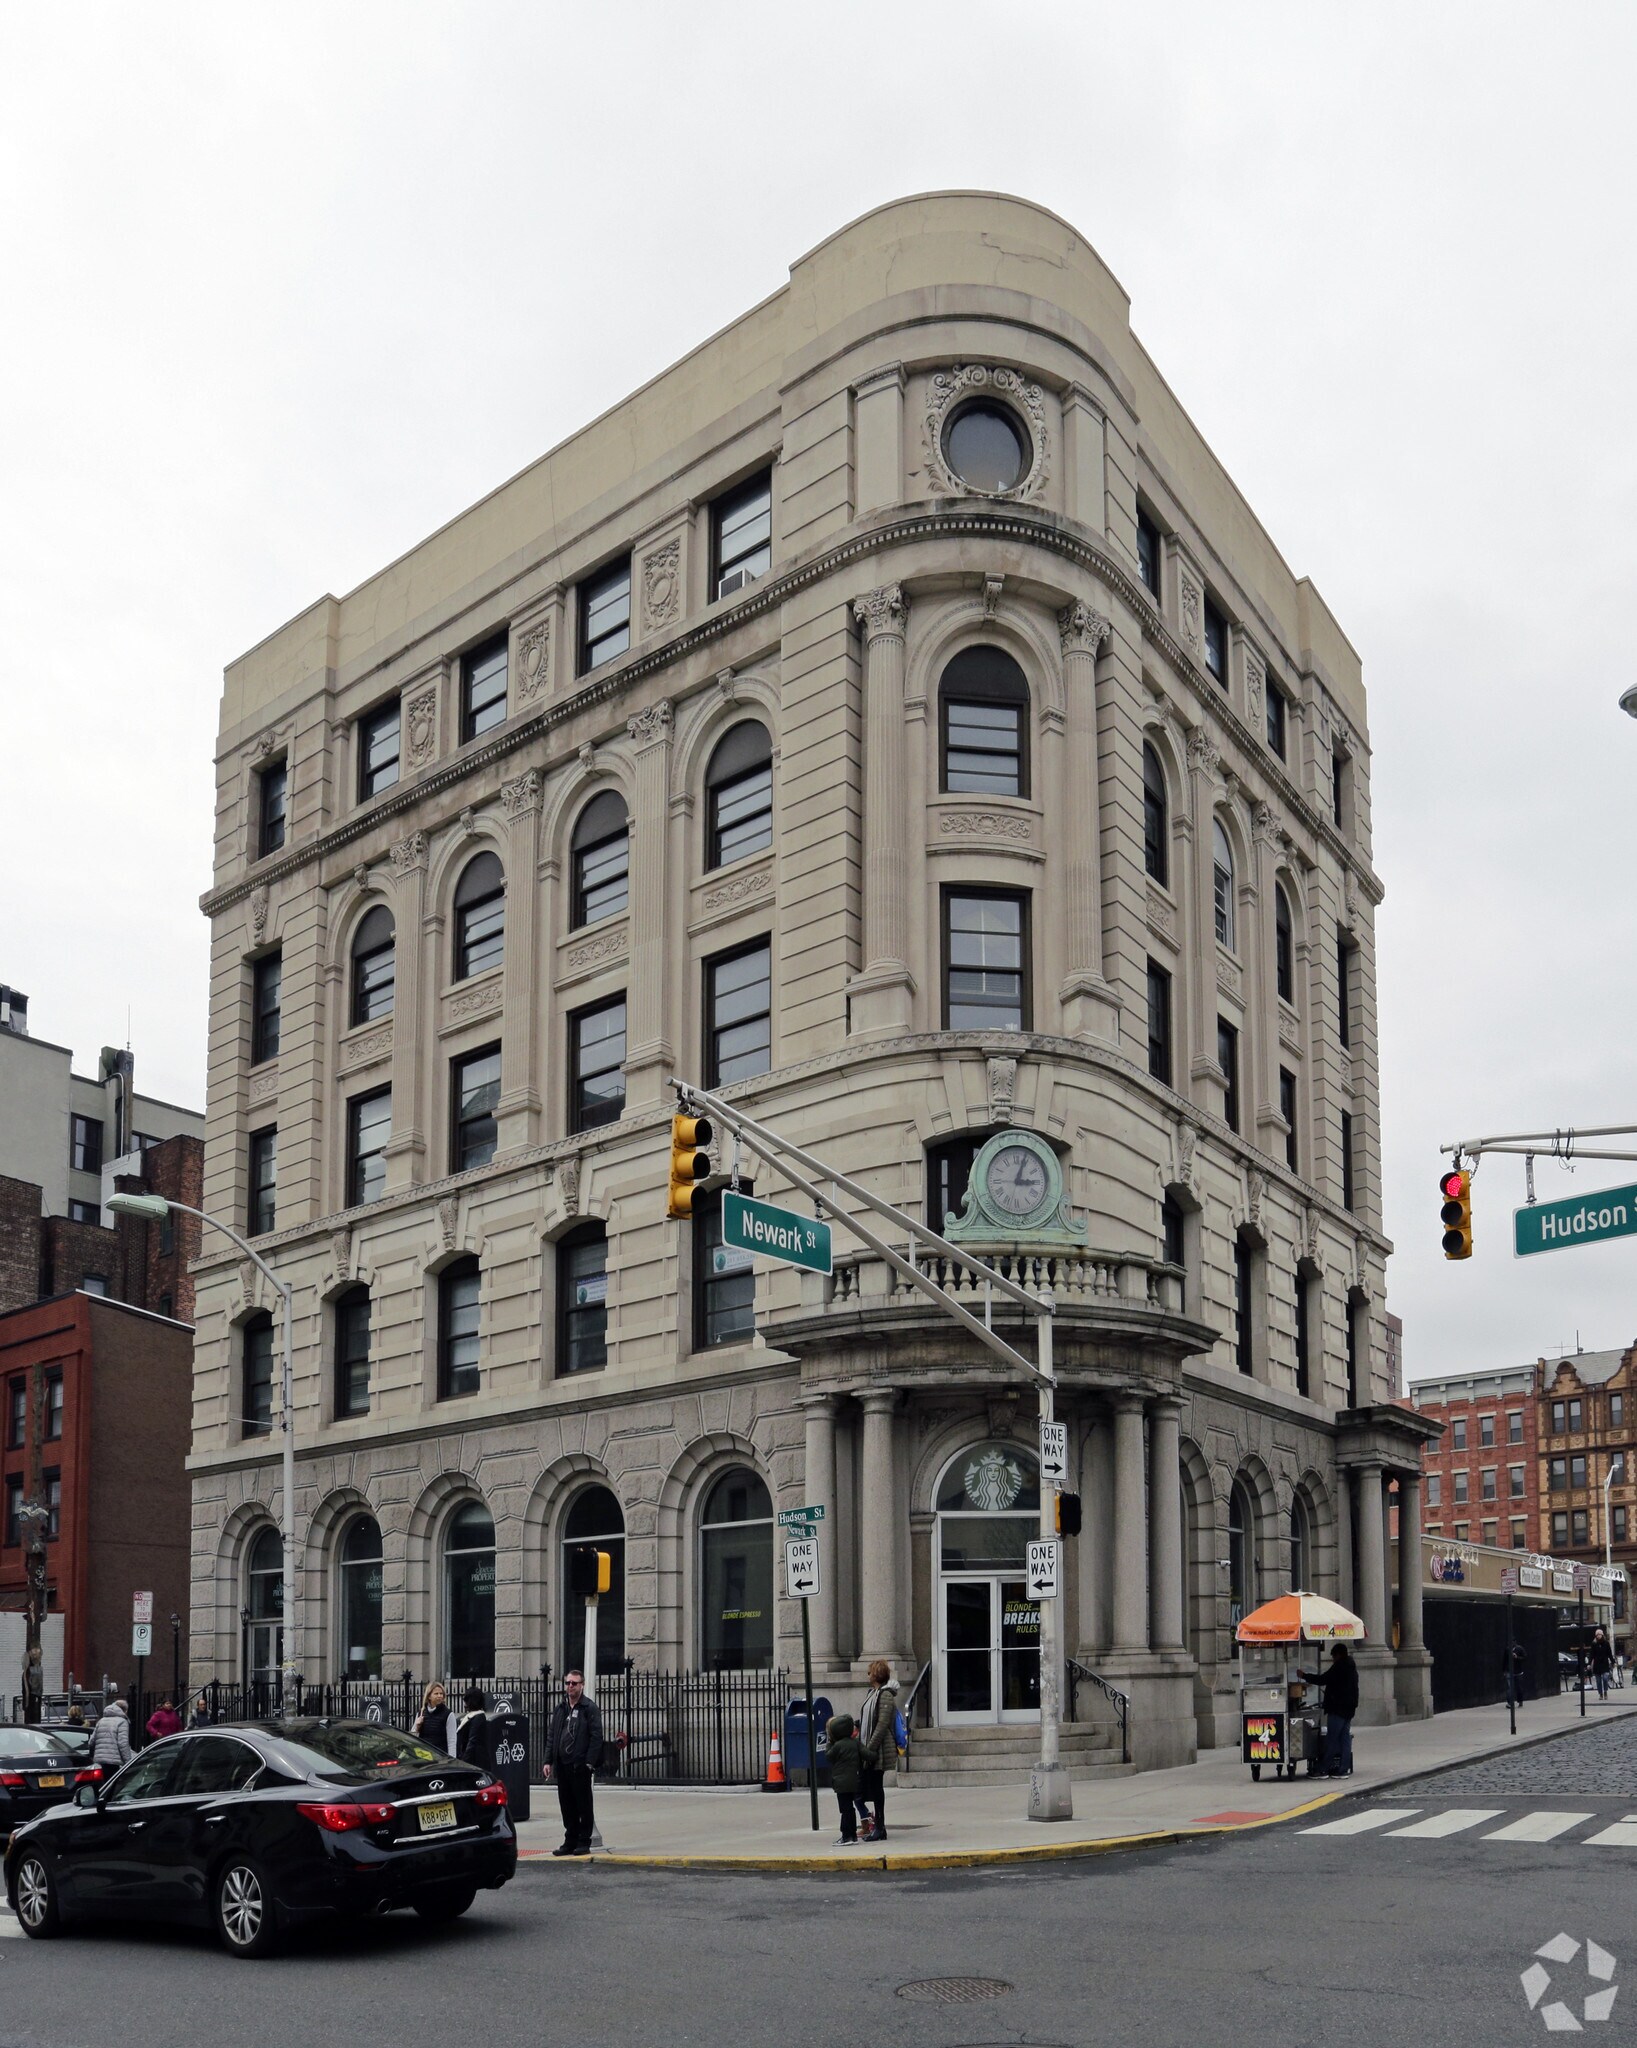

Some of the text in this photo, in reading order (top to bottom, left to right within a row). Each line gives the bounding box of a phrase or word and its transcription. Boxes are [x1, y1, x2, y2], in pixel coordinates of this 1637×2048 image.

[1541, 1206, 1627, 1241] Hudson
[742, 1209, 816, 1254] Newark St
[1043, 1427, 1064, 1442] ONE
[1043, 1443, 1064, 1458] WAY
[779, 1507, 825, 1524] Hudson St.
[787, 1523, 806, 1537] Newark
[792, 1544, 812, 1557] ONE
[1031, 1545, 1054, 1560] ONE
[792, 1560, 813, 1573] WAY
[1031, 1561, 1055, 1575] WAY
[471, 1573, 495, 1582] PROPERT
[1005, 1603, 1033, 1612] BLONDE
[1003, 1612, 1040, 1625] BREAKS
[1015, 1625, 1038, 1633] RULES
[1328, 1627, 1336, 1637] 4
[1247, 1718, 1277, 1736] NUTS
[1258, 1729, 1270, 1745] 4
[1250, 1741, 1281, 1759] NUTS
